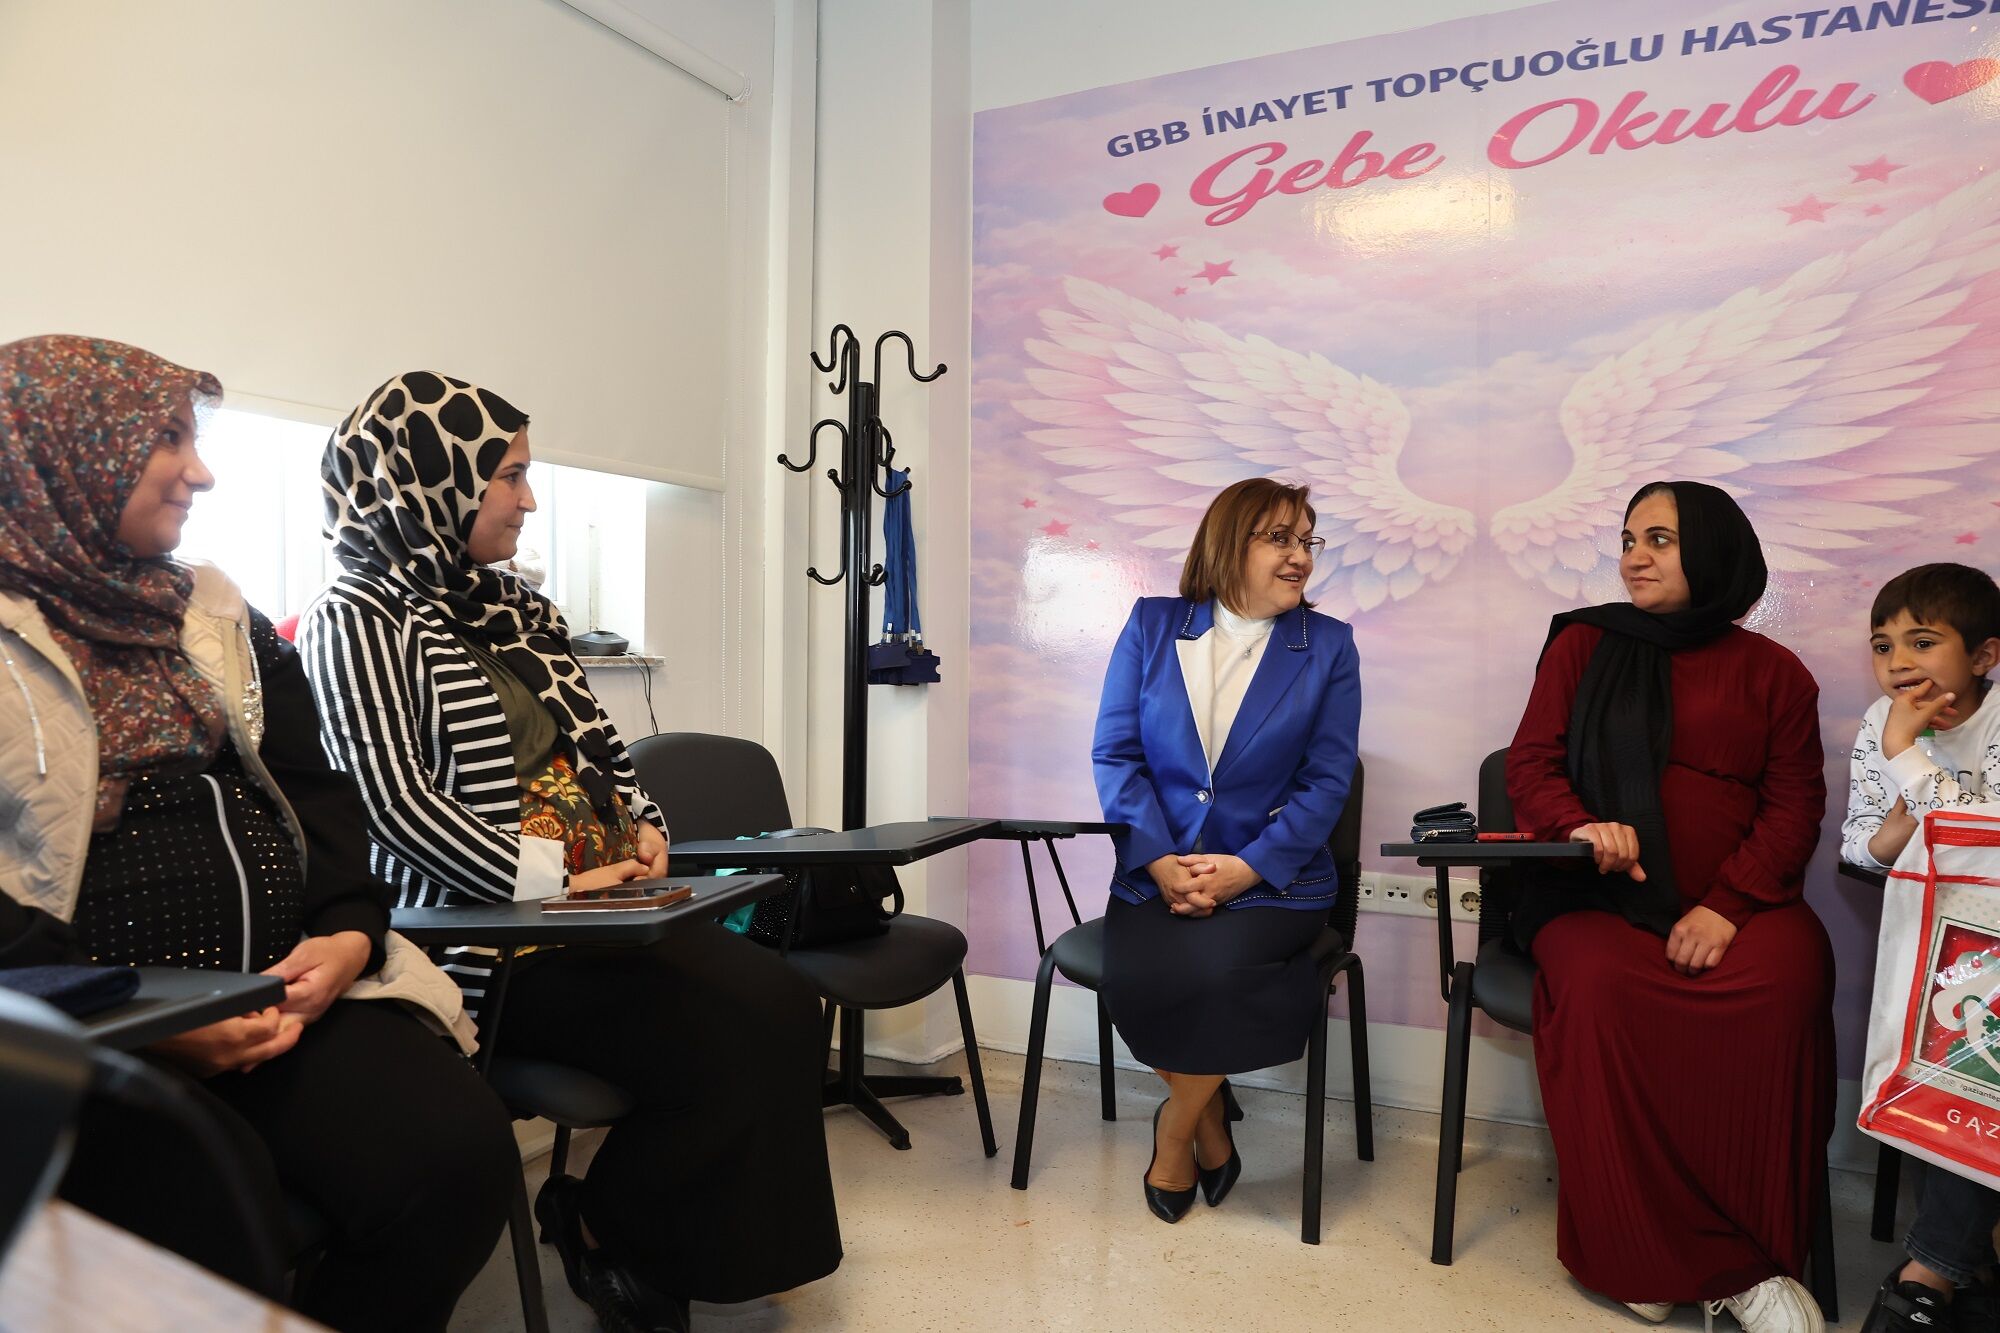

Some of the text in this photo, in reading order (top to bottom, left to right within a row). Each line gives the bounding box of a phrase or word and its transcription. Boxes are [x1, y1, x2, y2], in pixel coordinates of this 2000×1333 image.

[1107, 121, 1190, 157] GBB
[1202, 85, 1353, 136] İNAYET
[1366, 34, 1664, 103] TOPÇUOĞLU
[1190, 64, 1877, 226] Gebe Okulu
